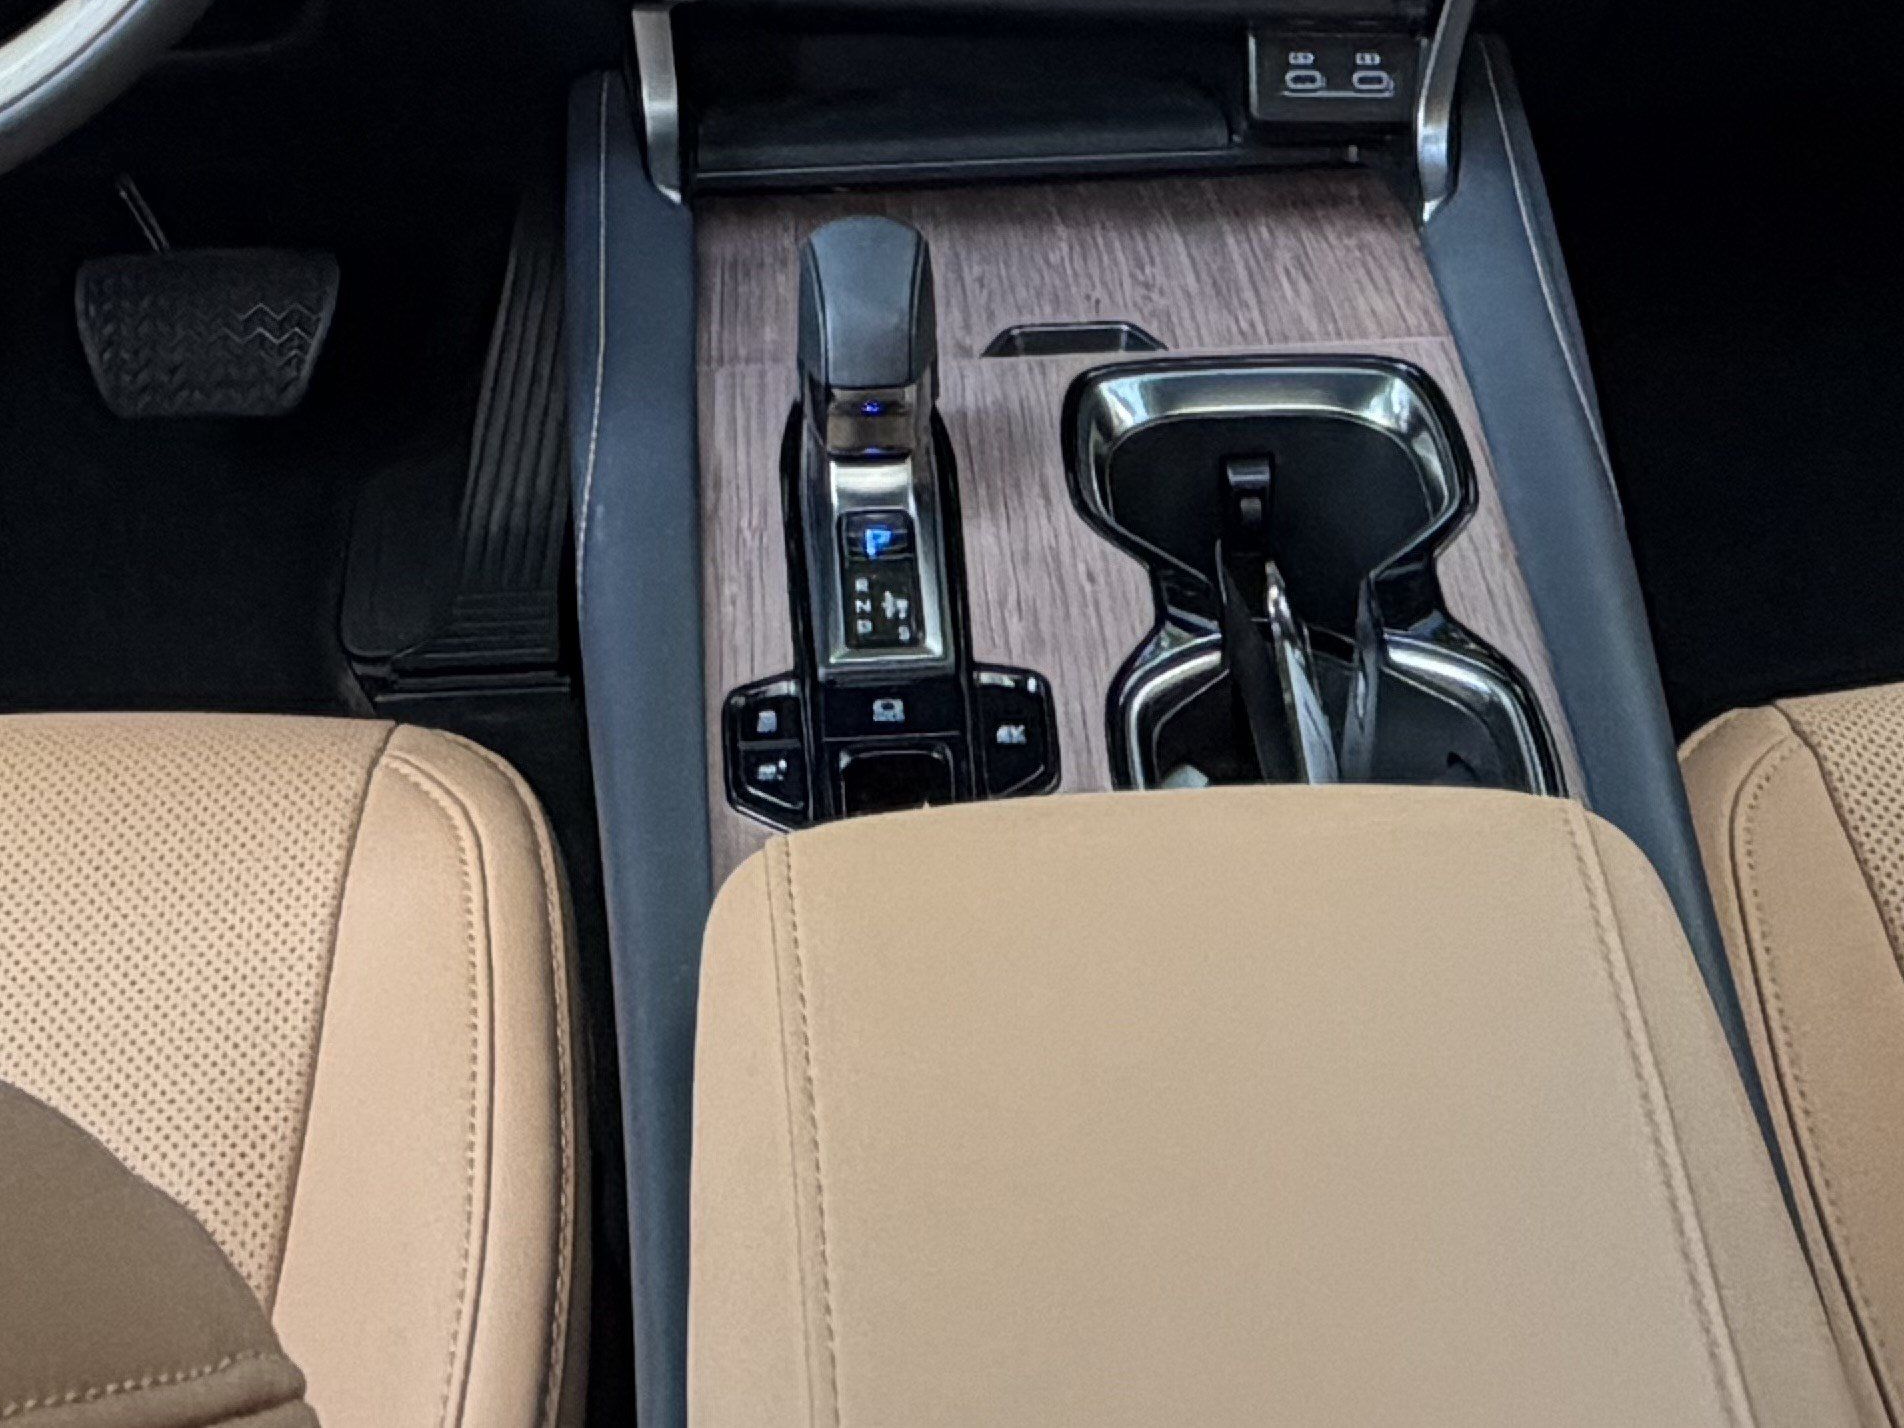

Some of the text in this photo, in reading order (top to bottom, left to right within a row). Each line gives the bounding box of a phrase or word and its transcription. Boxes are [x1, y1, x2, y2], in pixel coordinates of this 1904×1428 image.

[864, 528, 892, 560] P
[855, 600, 872, 614] N
[856, 618, 873, 635] D
